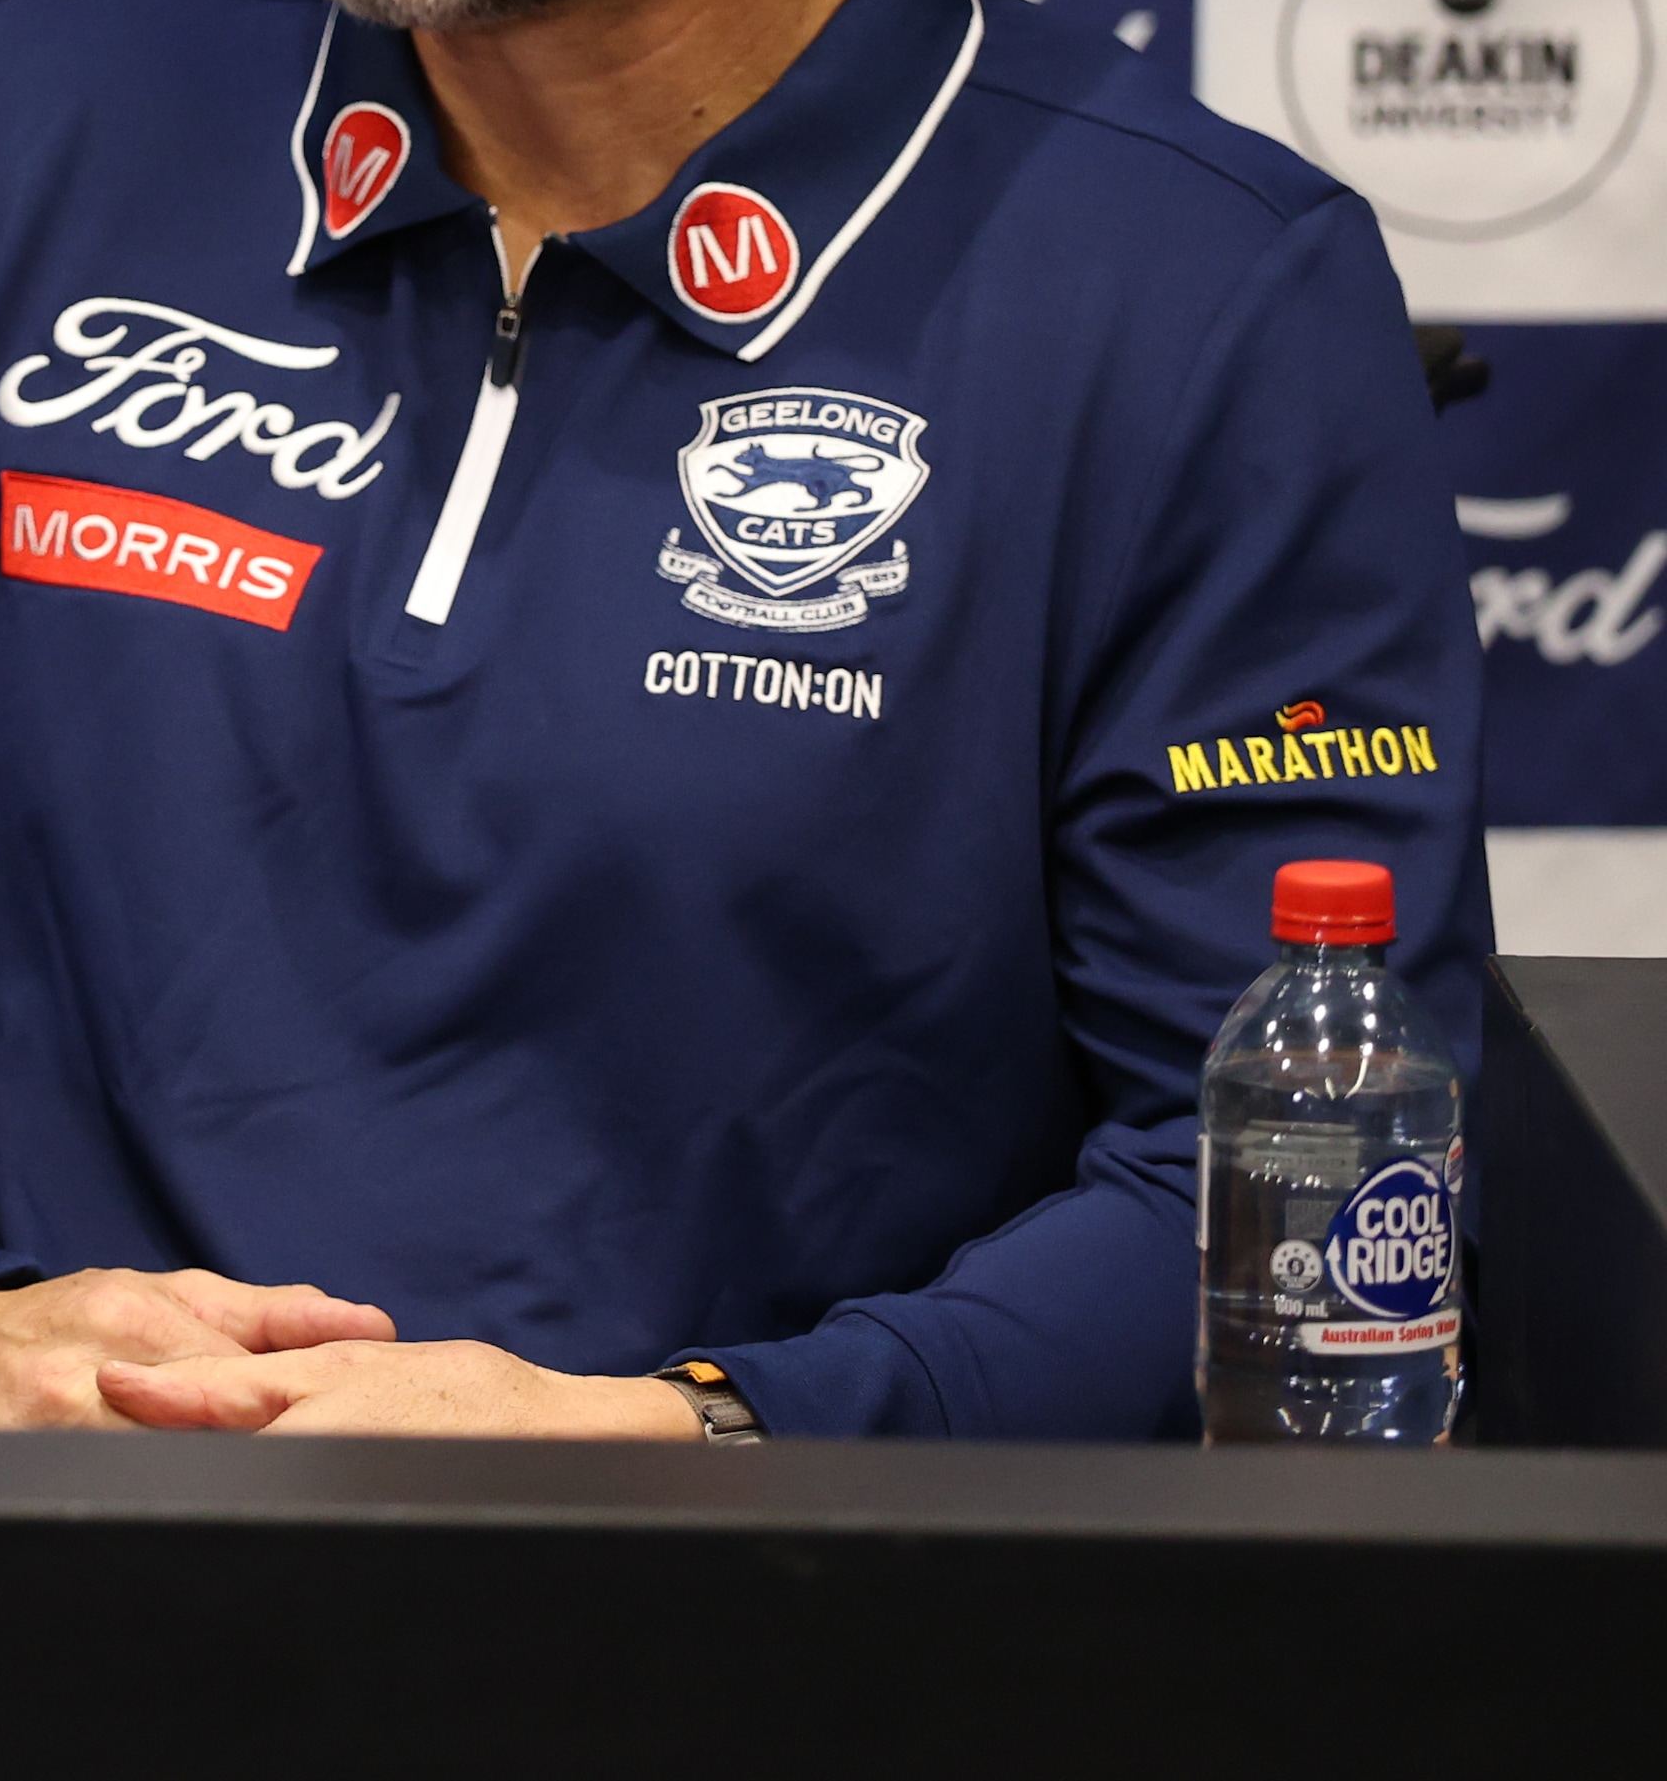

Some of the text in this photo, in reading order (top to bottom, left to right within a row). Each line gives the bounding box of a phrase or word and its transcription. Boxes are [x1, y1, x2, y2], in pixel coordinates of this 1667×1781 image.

[1352, 34, 1578, 89] DEAKIN
[1350, 103, 1576, 136] UNIVERSITY
[686, 213, 778, 289] M
[720, 400, 901, 445] GEELONG
[12, 504, 294, 600] MORRIS
[736, 517, 836, 546] CATS
[800, 601, 856, 621] CLUB
[1167, 726, 1438, 794] MARATHON
[1355, 1193, 1445, 1239] COOL
[1347, 1233, 1449, 1286] RIDGE
[1321, 1327, 1394, 1344] Australian
